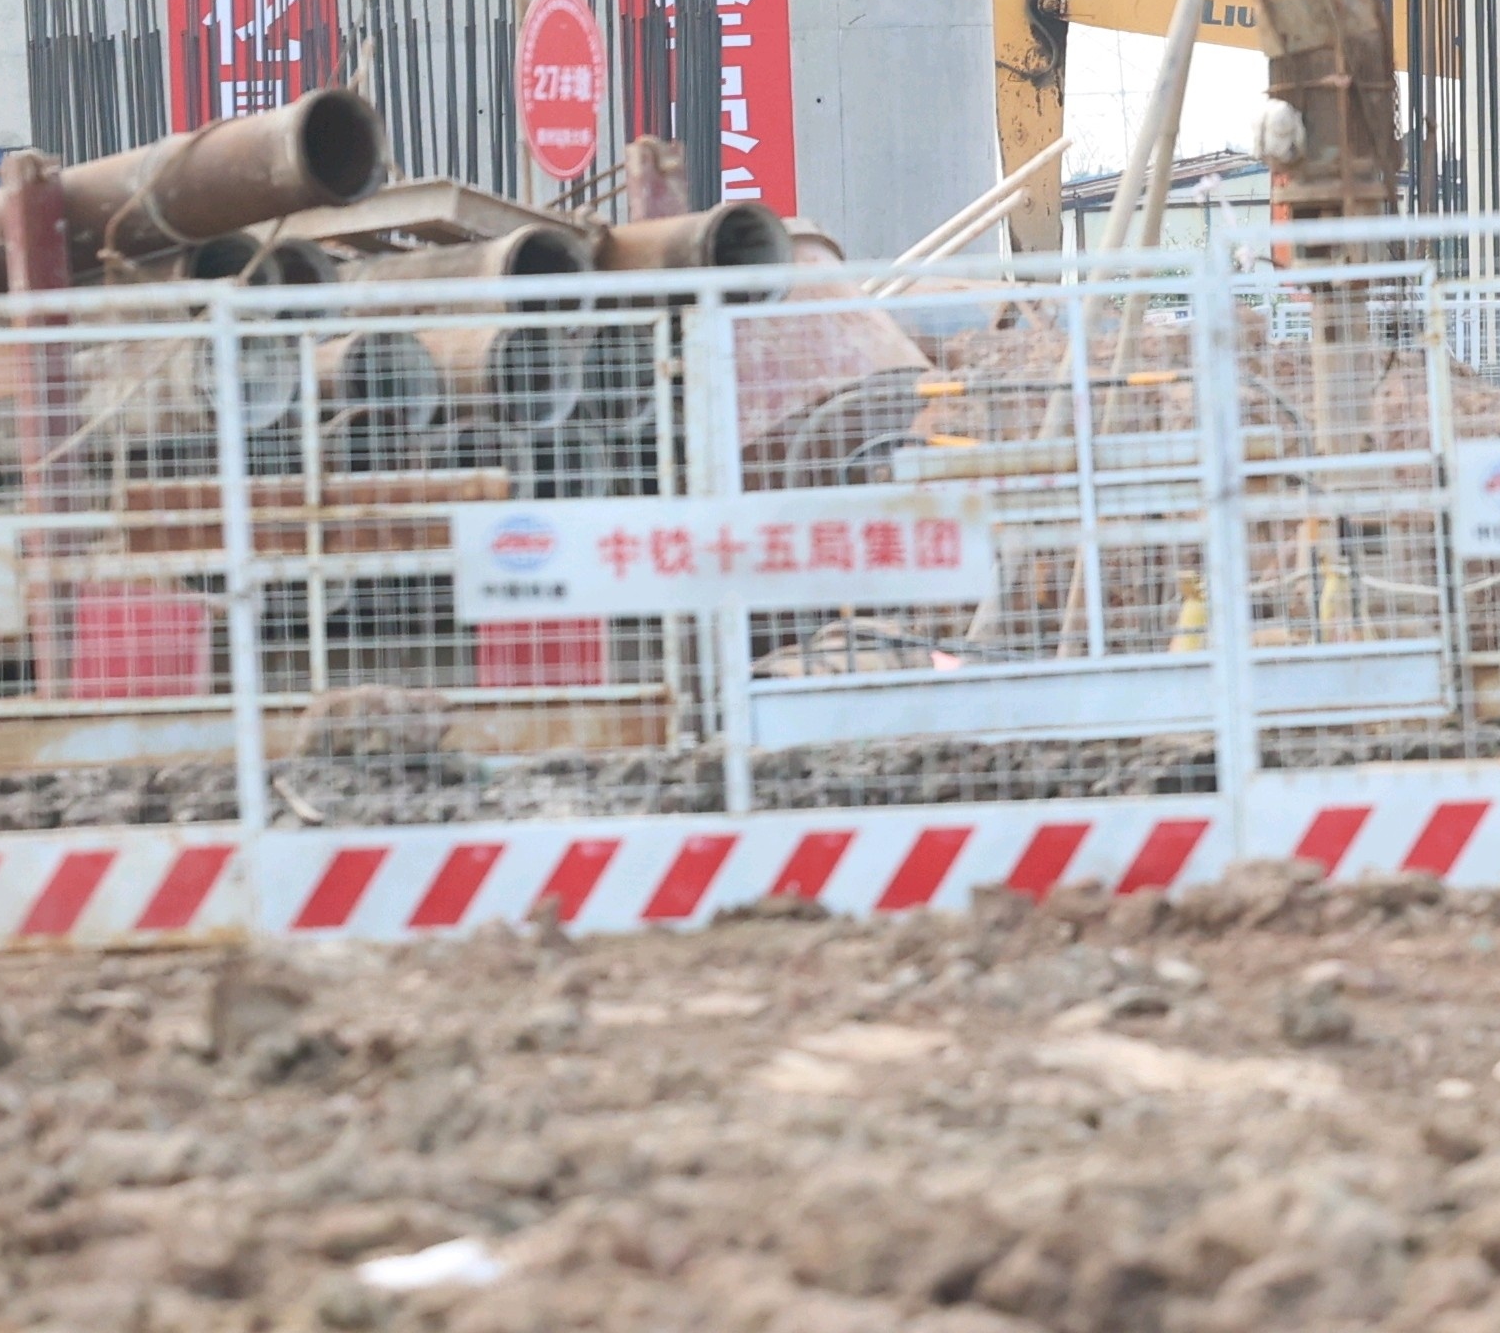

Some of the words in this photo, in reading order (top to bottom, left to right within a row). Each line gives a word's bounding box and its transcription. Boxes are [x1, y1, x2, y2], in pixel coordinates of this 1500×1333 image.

[596, 517, 963, 582] 中铁十五局集团
